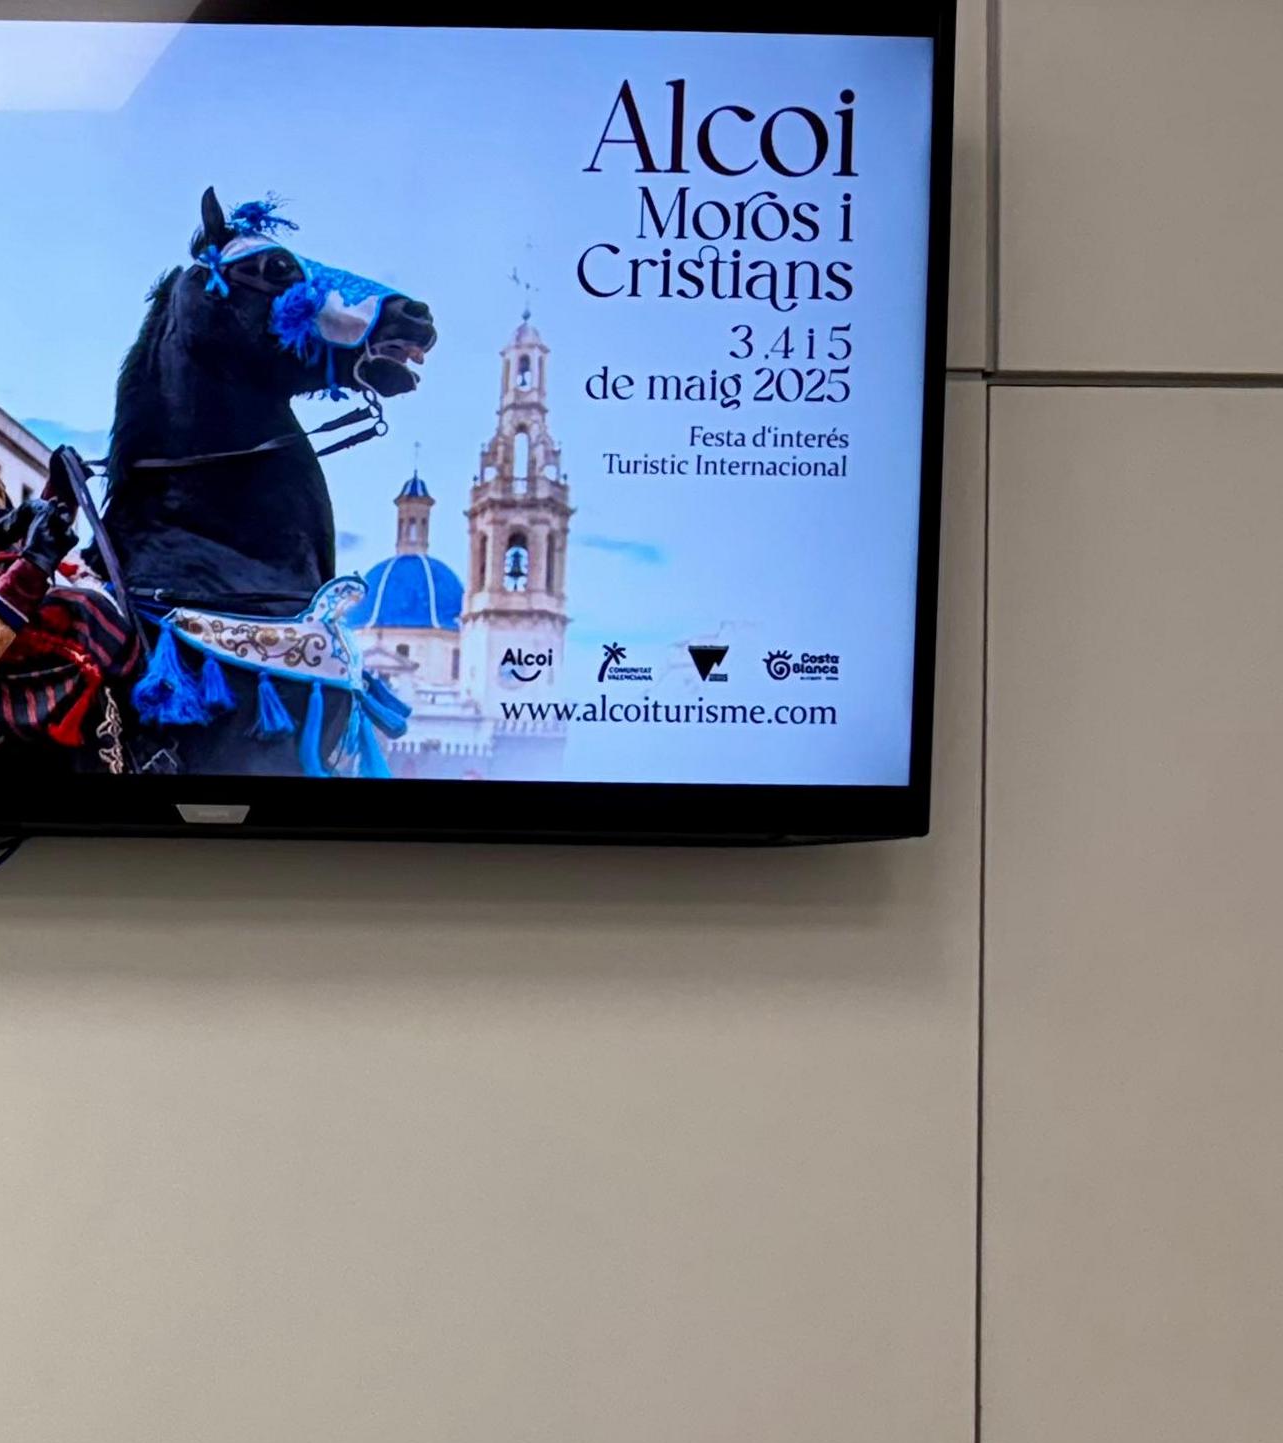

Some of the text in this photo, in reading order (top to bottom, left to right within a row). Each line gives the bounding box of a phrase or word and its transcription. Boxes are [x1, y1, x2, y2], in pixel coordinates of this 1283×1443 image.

[582, 78, 859, 178] Alcoi
[637, 186, 853, 242] Moros i
[577, 244, 853, 312] Cristians
[585, 365, 851, 409] de maig 2025
[689, 425, 746, 448] Festa
[602, 453, 847, 477] Turistic Internacional
[500, 648, 553, 667] Alcoi
[792, 663, 839, 675] Blanca
[800, 652, 840, 664] Costa
[500, 694, 837, 725] www.alcoiturisme.com
